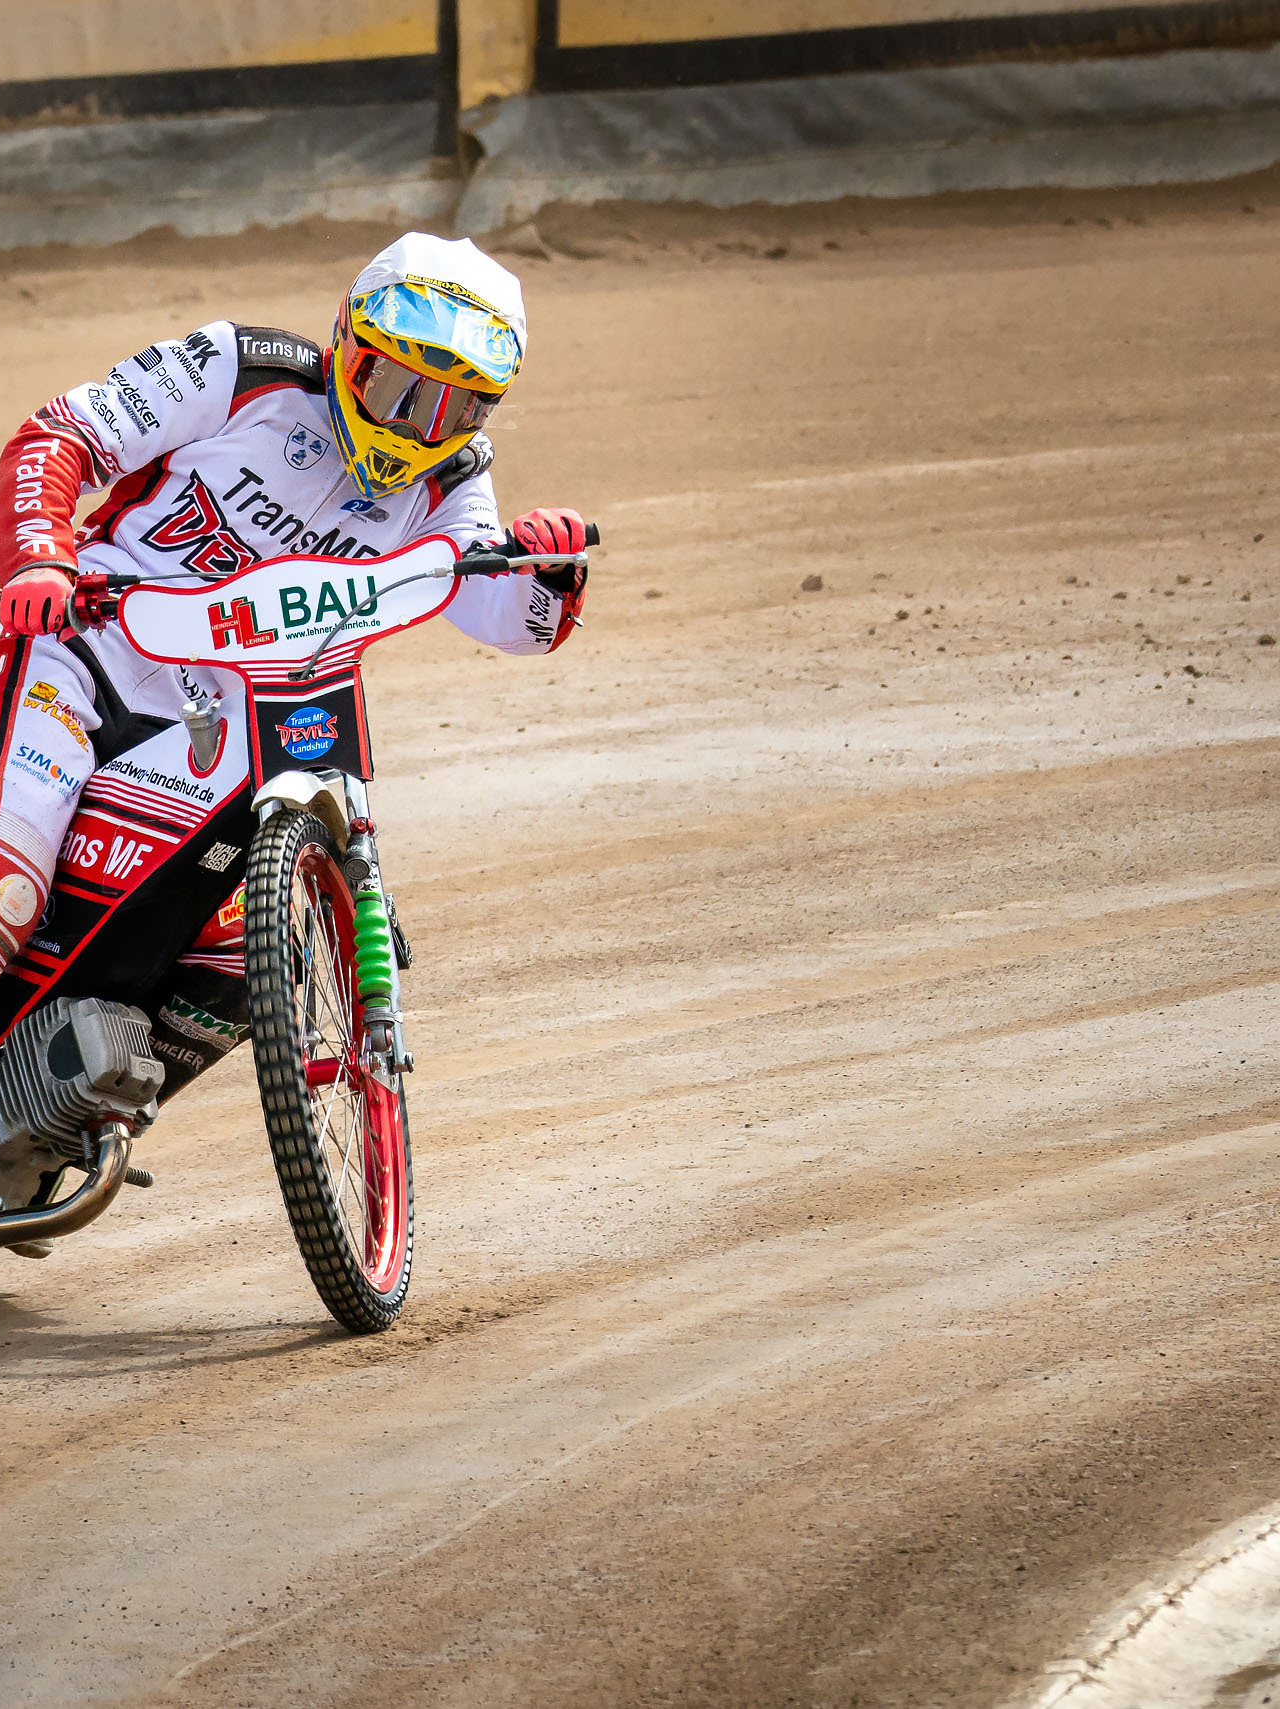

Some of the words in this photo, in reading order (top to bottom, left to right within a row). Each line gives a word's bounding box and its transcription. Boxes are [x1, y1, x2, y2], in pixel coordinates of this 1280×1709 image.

[238, 336, 294, 359] Trans
[296, 346, 319, 368] MF
[13, 438, 61, 513] Trans
[15, 518, 57, 556] MF
[278, 575, 379, 629] BAU
[206, 596, 280, 651] HL
[211, 619, 239, 632] HEINRICH
[245, 635, 271, 646] LEHNER
[22, 697, 89, 753] WYLEZOL
[274, 715, 339, 748] DEVILS
[290, 716, 312, 726] Trans
[312, 712, 325, 722] MF
[291, 740, 329, 754] Landshut
[10, 759, 50, 785] werbeartikel
[16, 745, 81, 792] SIMONI
[58, 831, 105, 868] ans
[102, 835, 154, 880] MF
